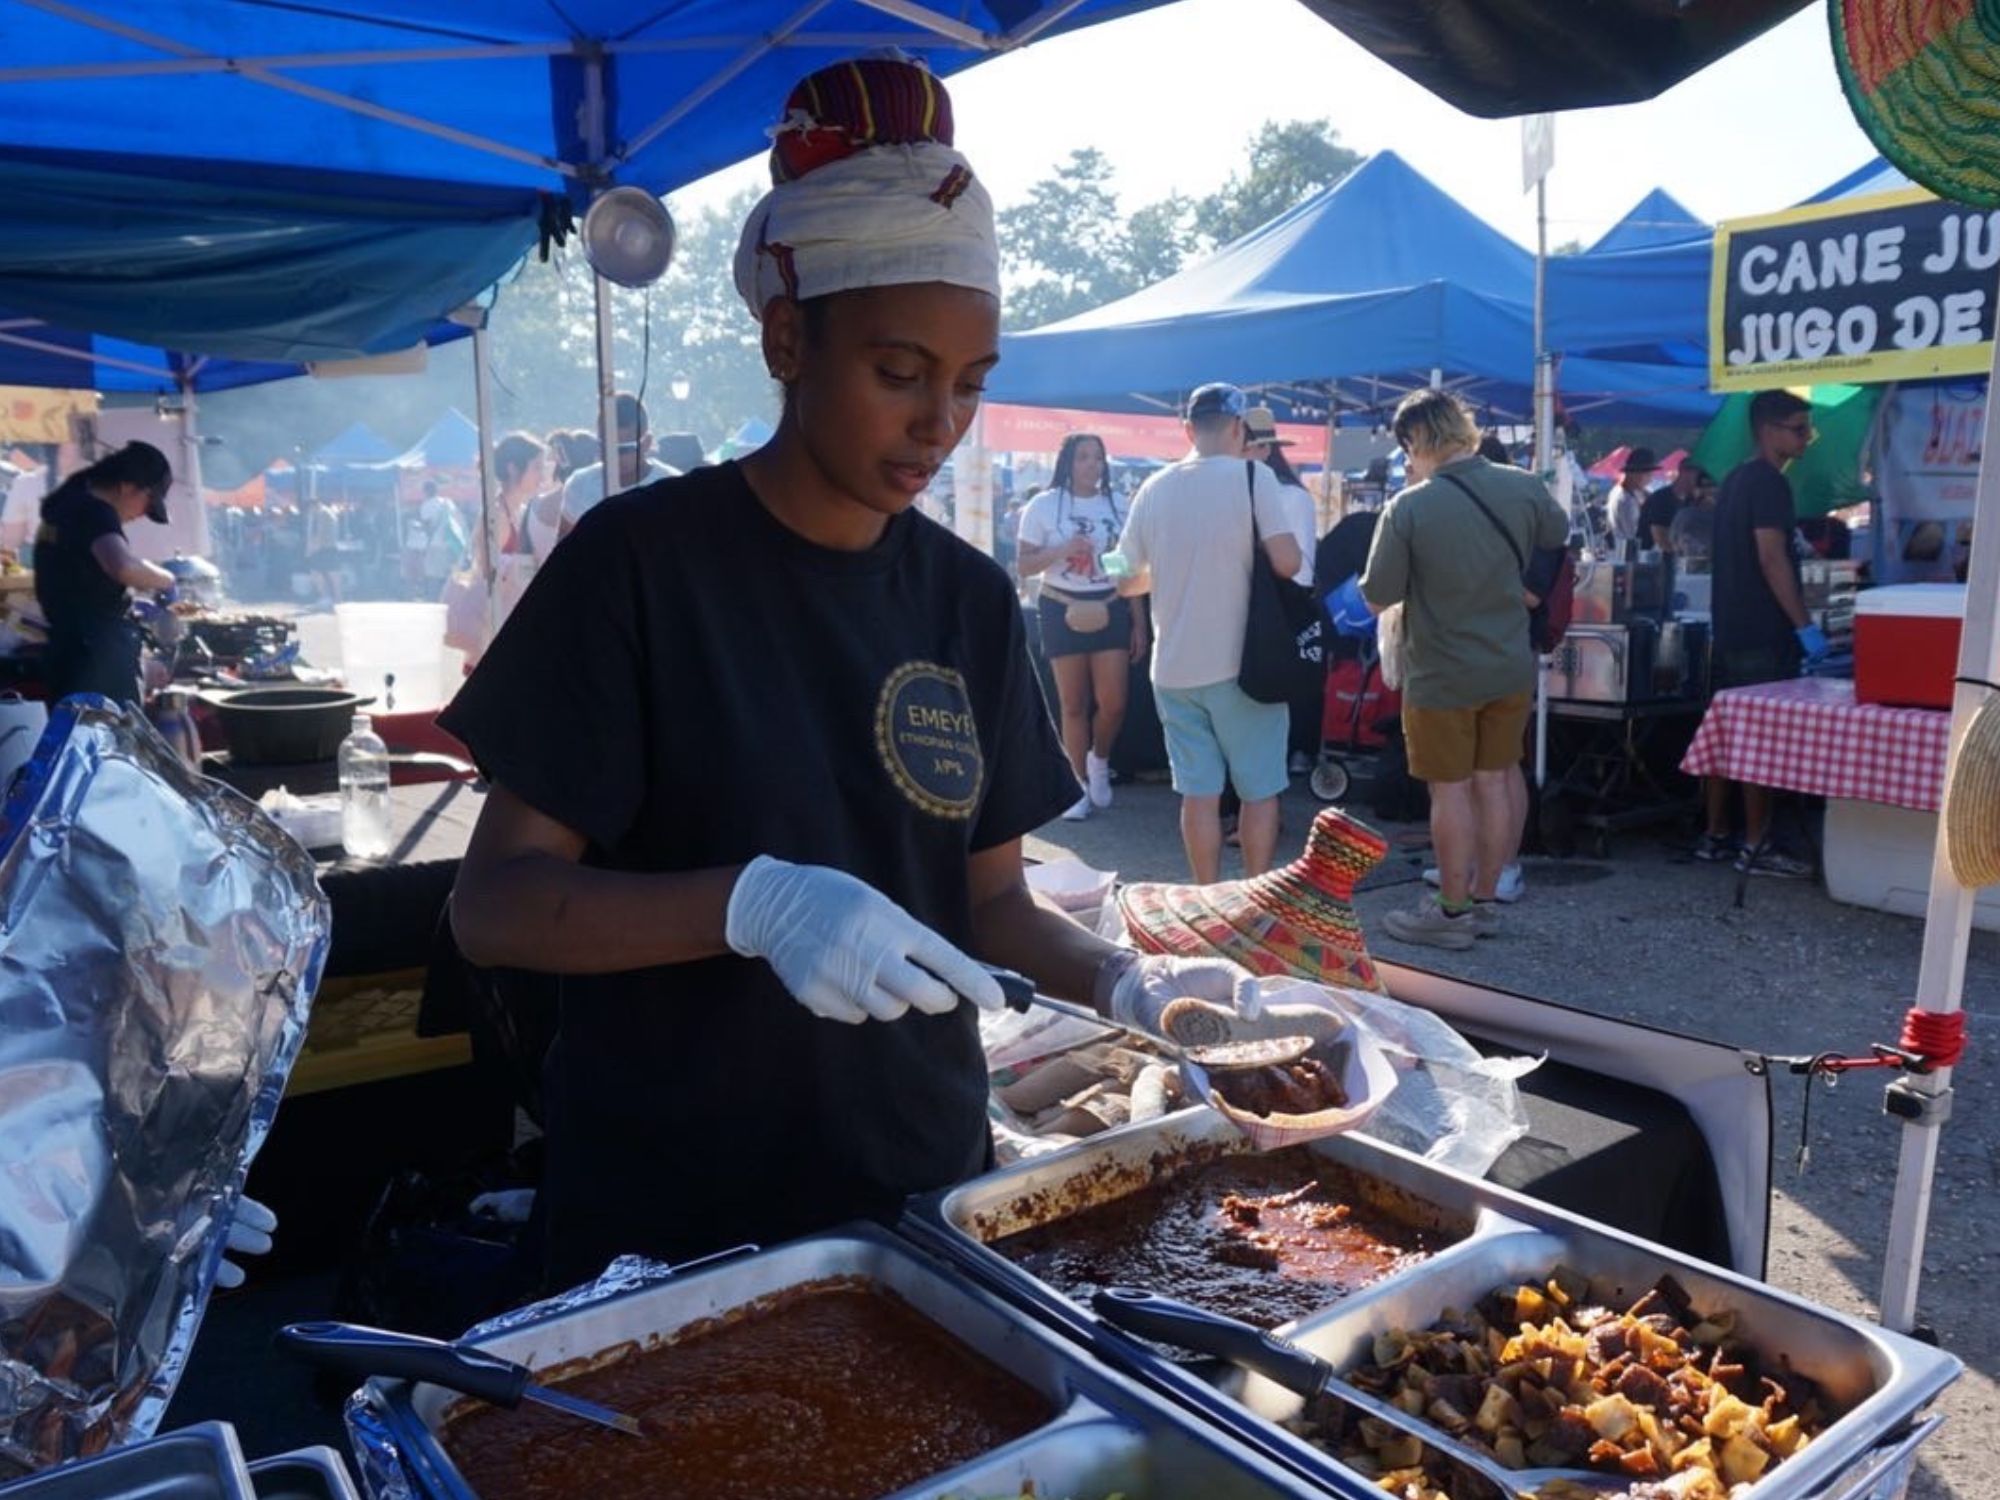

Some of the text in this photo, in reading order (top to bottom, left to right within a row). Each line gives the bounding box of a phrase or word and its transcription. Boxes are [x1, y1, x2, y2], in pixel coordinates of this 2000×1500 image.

[1739, 211, 2000, 295] CANE JU
[1728, 289, 1986, 366] JUGO DE
